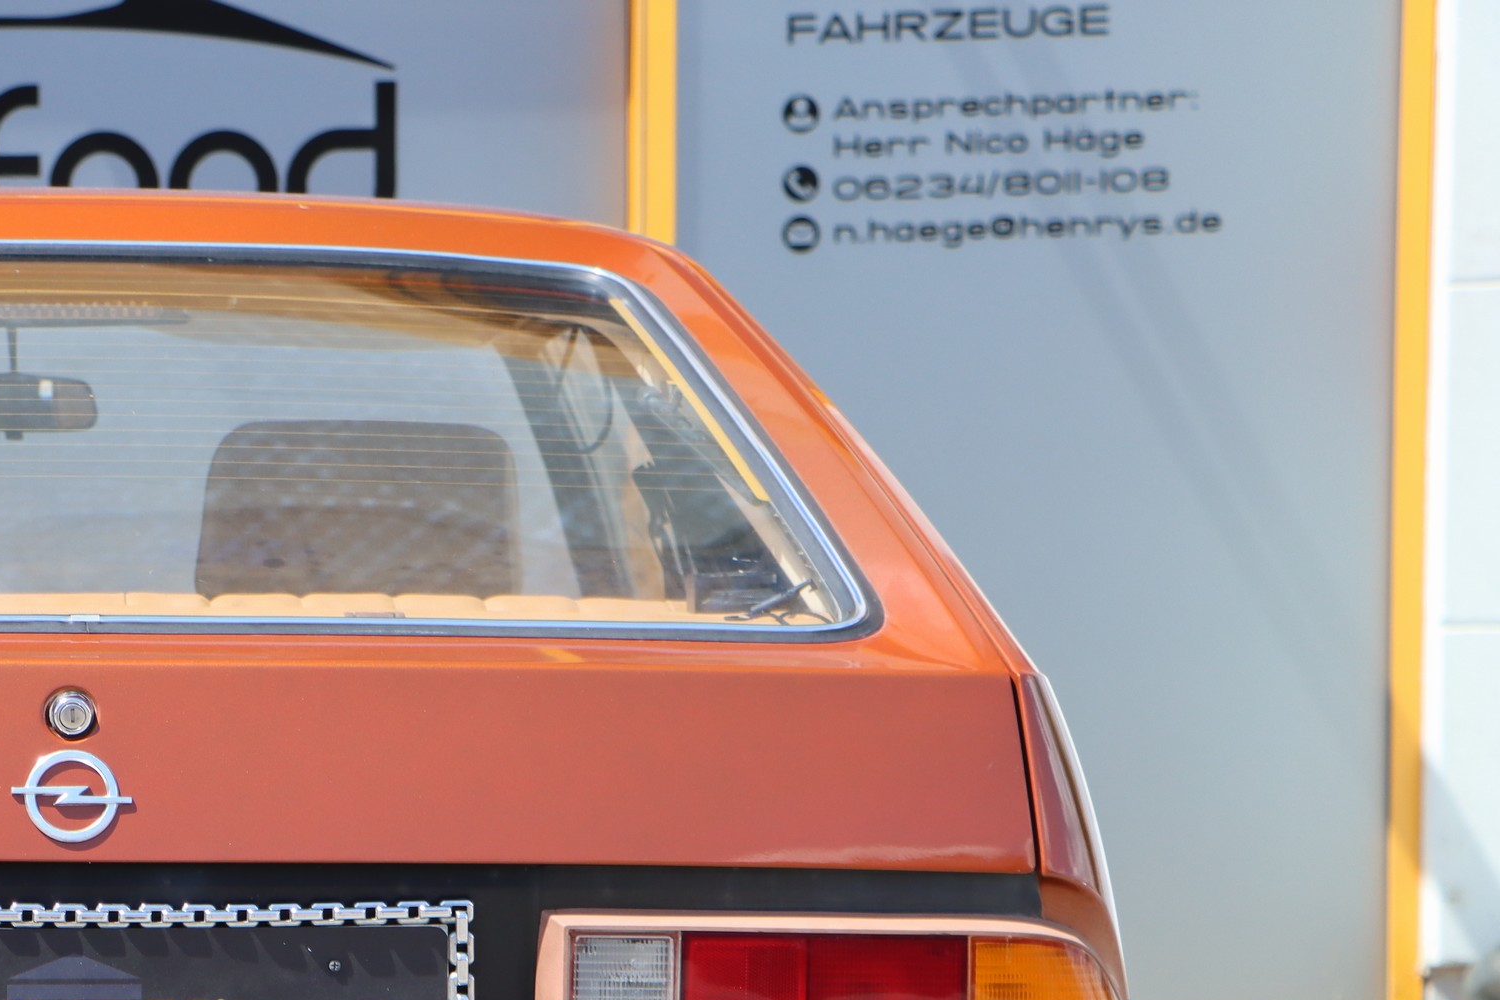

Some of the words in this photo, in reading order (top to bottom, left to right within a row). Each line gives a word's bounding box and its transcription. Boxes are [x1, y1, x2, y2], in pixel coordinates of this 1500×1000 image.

[785, 4, 1112, 46] FAHRZEUGE
[832, 87, 1199, 122] Ansprechpartner:
[831, 133, 932, 159] Herr
[943, 129, 1030, 156] Nico
[831, 166, 1171, 202] 06234/8011-108
[832, 209, 1224, 250] n.haege@henrys.de
